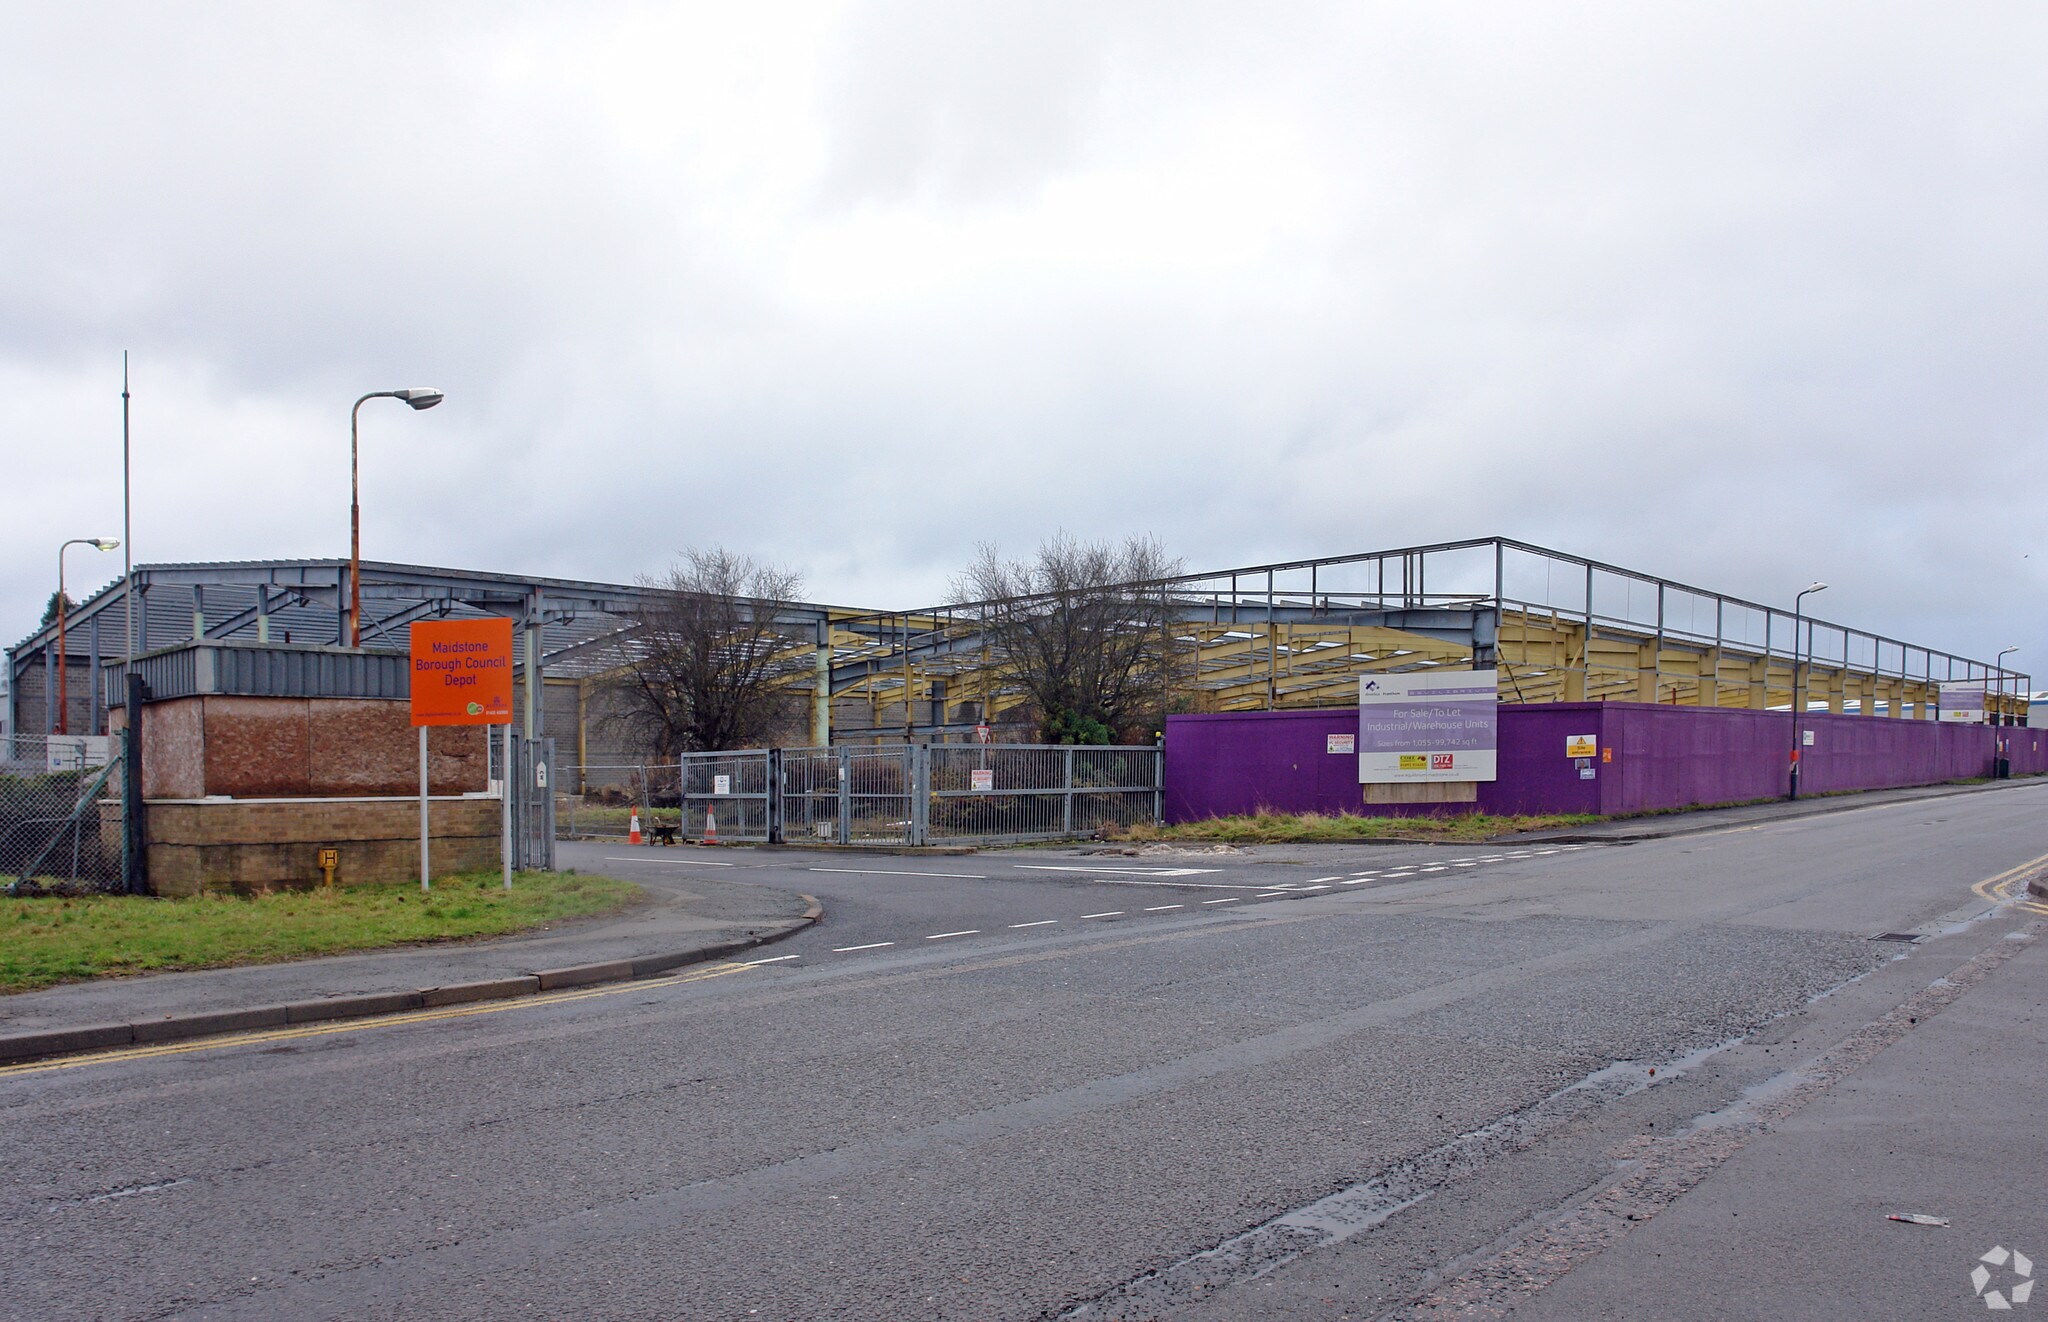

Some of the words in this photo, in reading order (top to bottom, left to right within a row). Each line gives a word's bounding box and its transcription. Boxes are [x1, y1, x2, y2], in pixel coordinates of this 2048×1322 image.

[432, 641, 488, 654] Maidstone
[416, 658, 462, 672] Borough
[465, 656, 507, 669] Council
[445, 674, 477, 688] Depot
[1393, 709, 1408, 719] For
[1447, 708, 1461, 717] Let
[1367, 721, 1462, 731] Industrial/Warehouse
[1465, 720, 1489, 729] Units
[1394, 739, 1411, 747] from
[1433, 755, 1451, 764] DTZ
[325, 851, 336, 864] H
